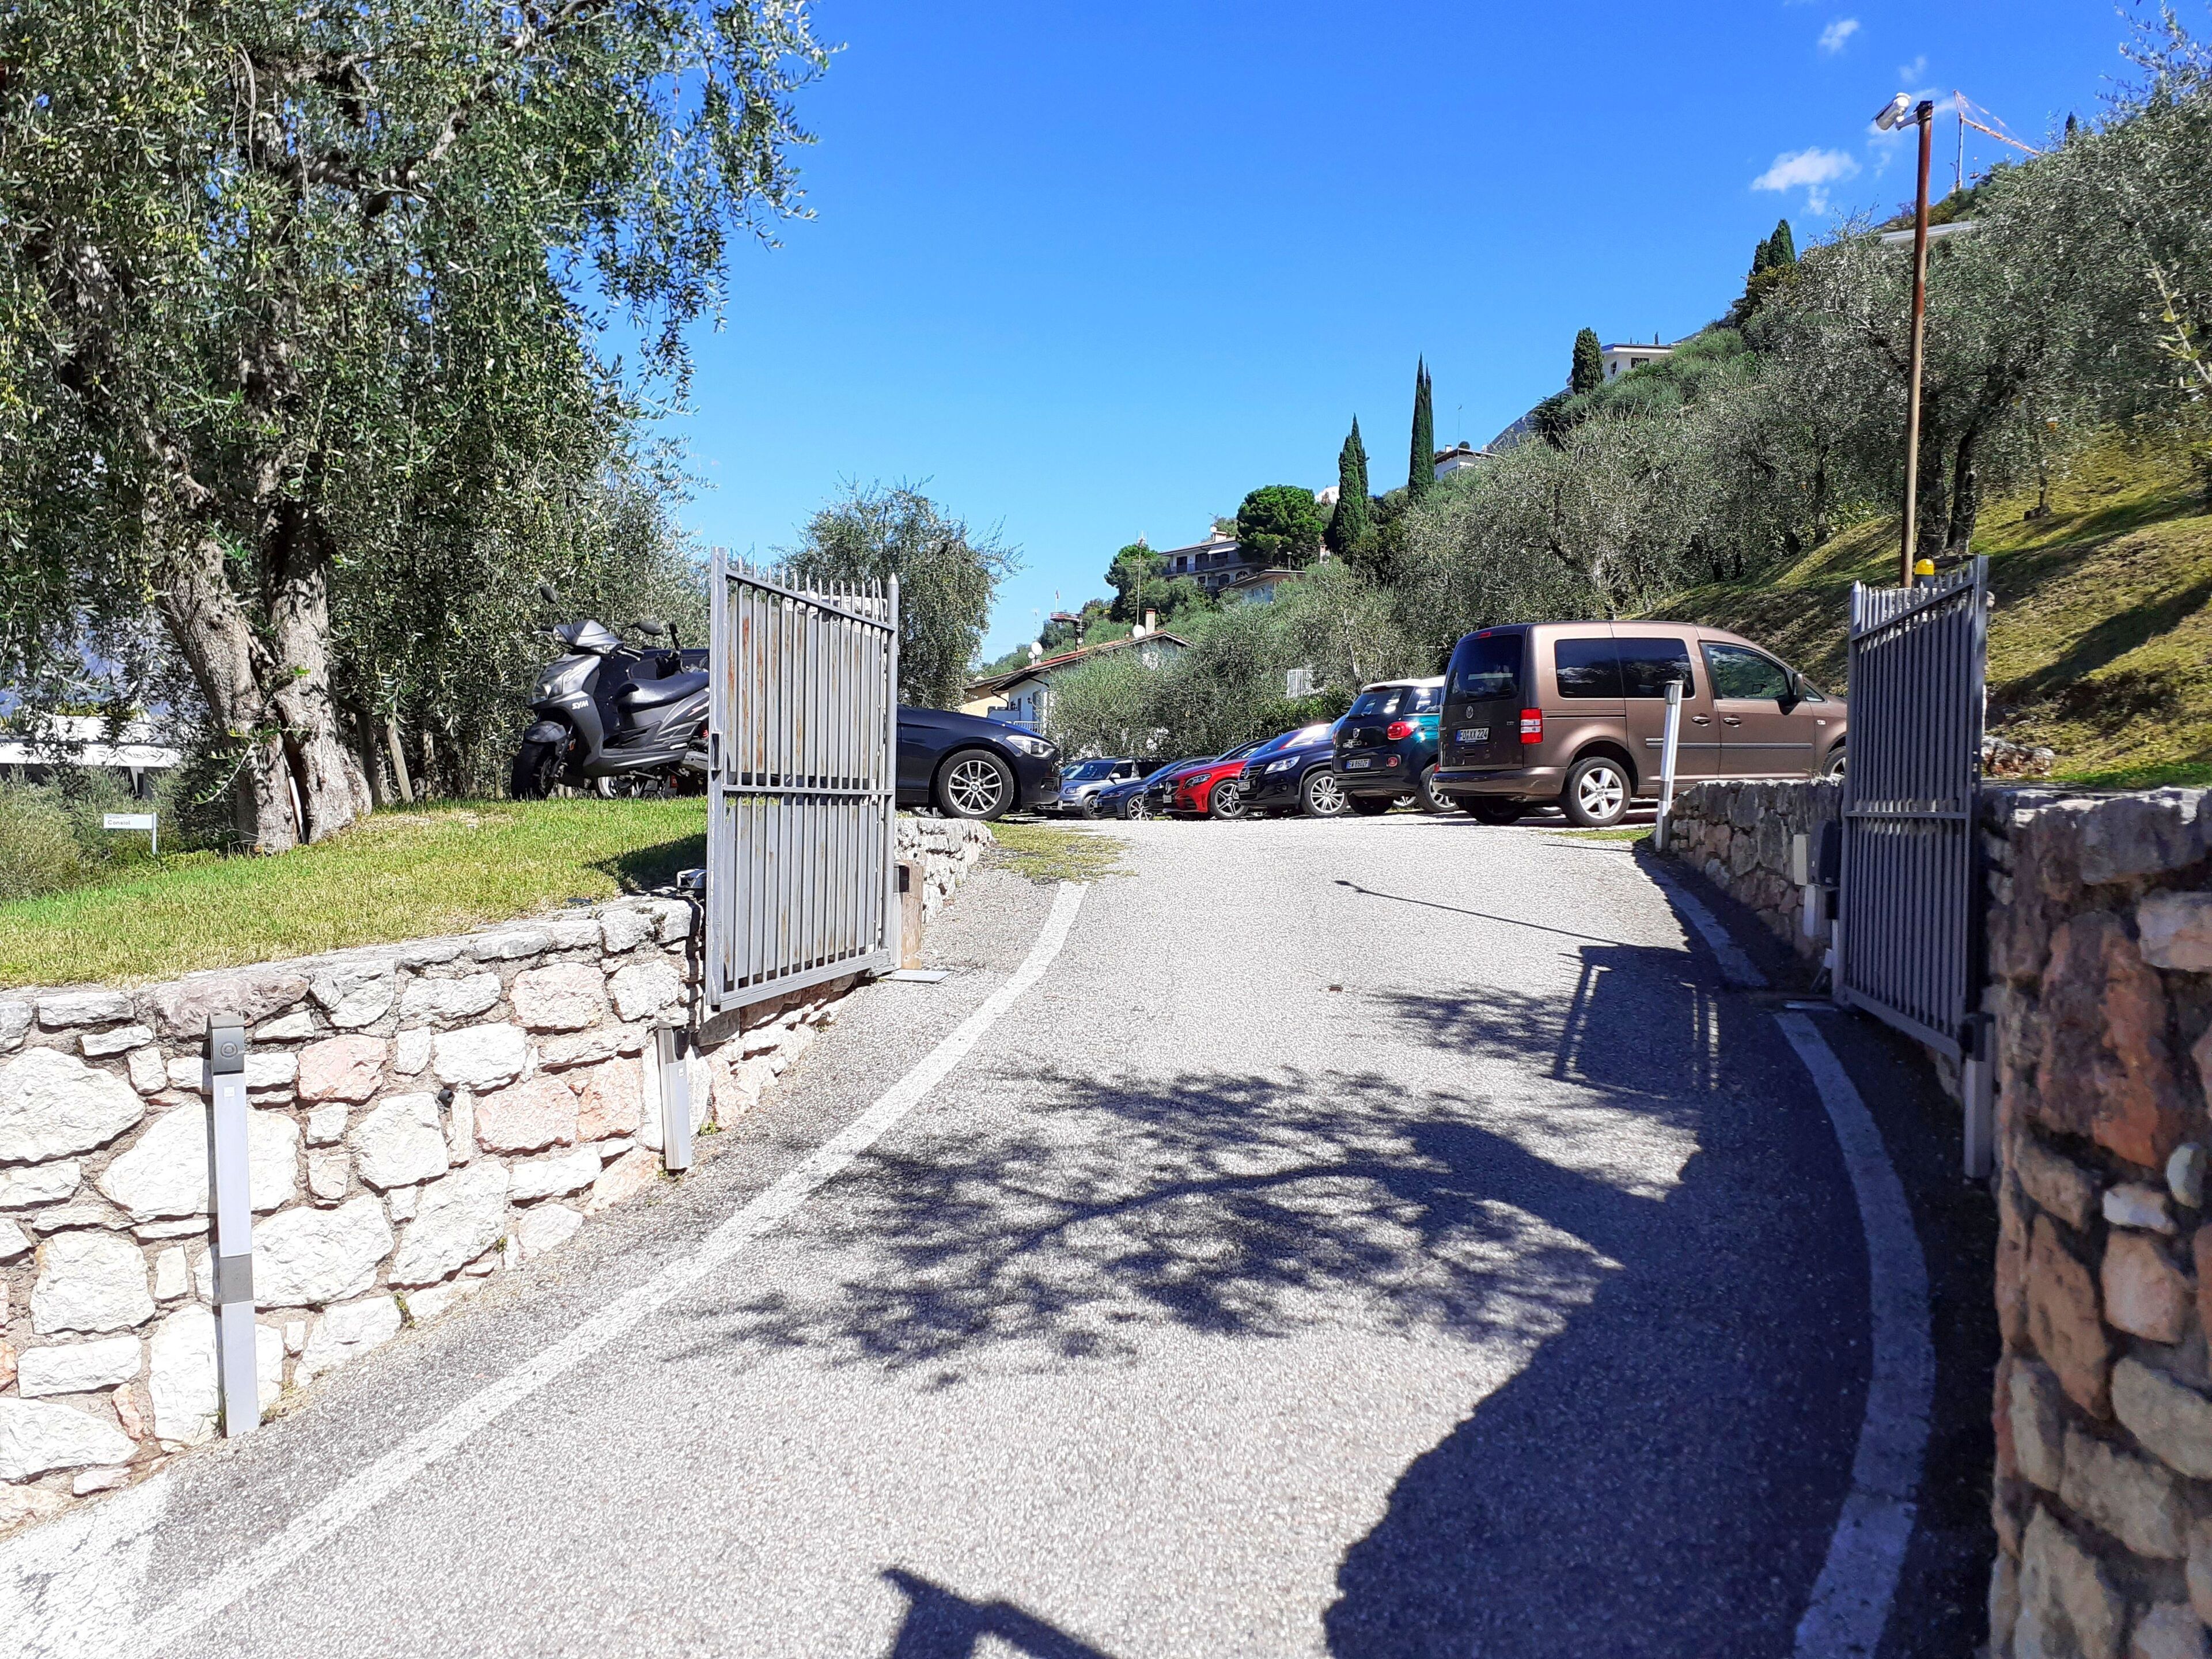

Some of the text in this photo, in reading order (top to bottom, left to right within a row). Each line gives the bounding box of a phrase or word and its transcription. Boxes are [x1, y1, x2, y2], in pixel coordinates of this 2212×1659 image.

[572, 700, 589, 710] SYM
[1469, 730, 1477, 739] XX
[1477, 729, 1488, 738] 224
